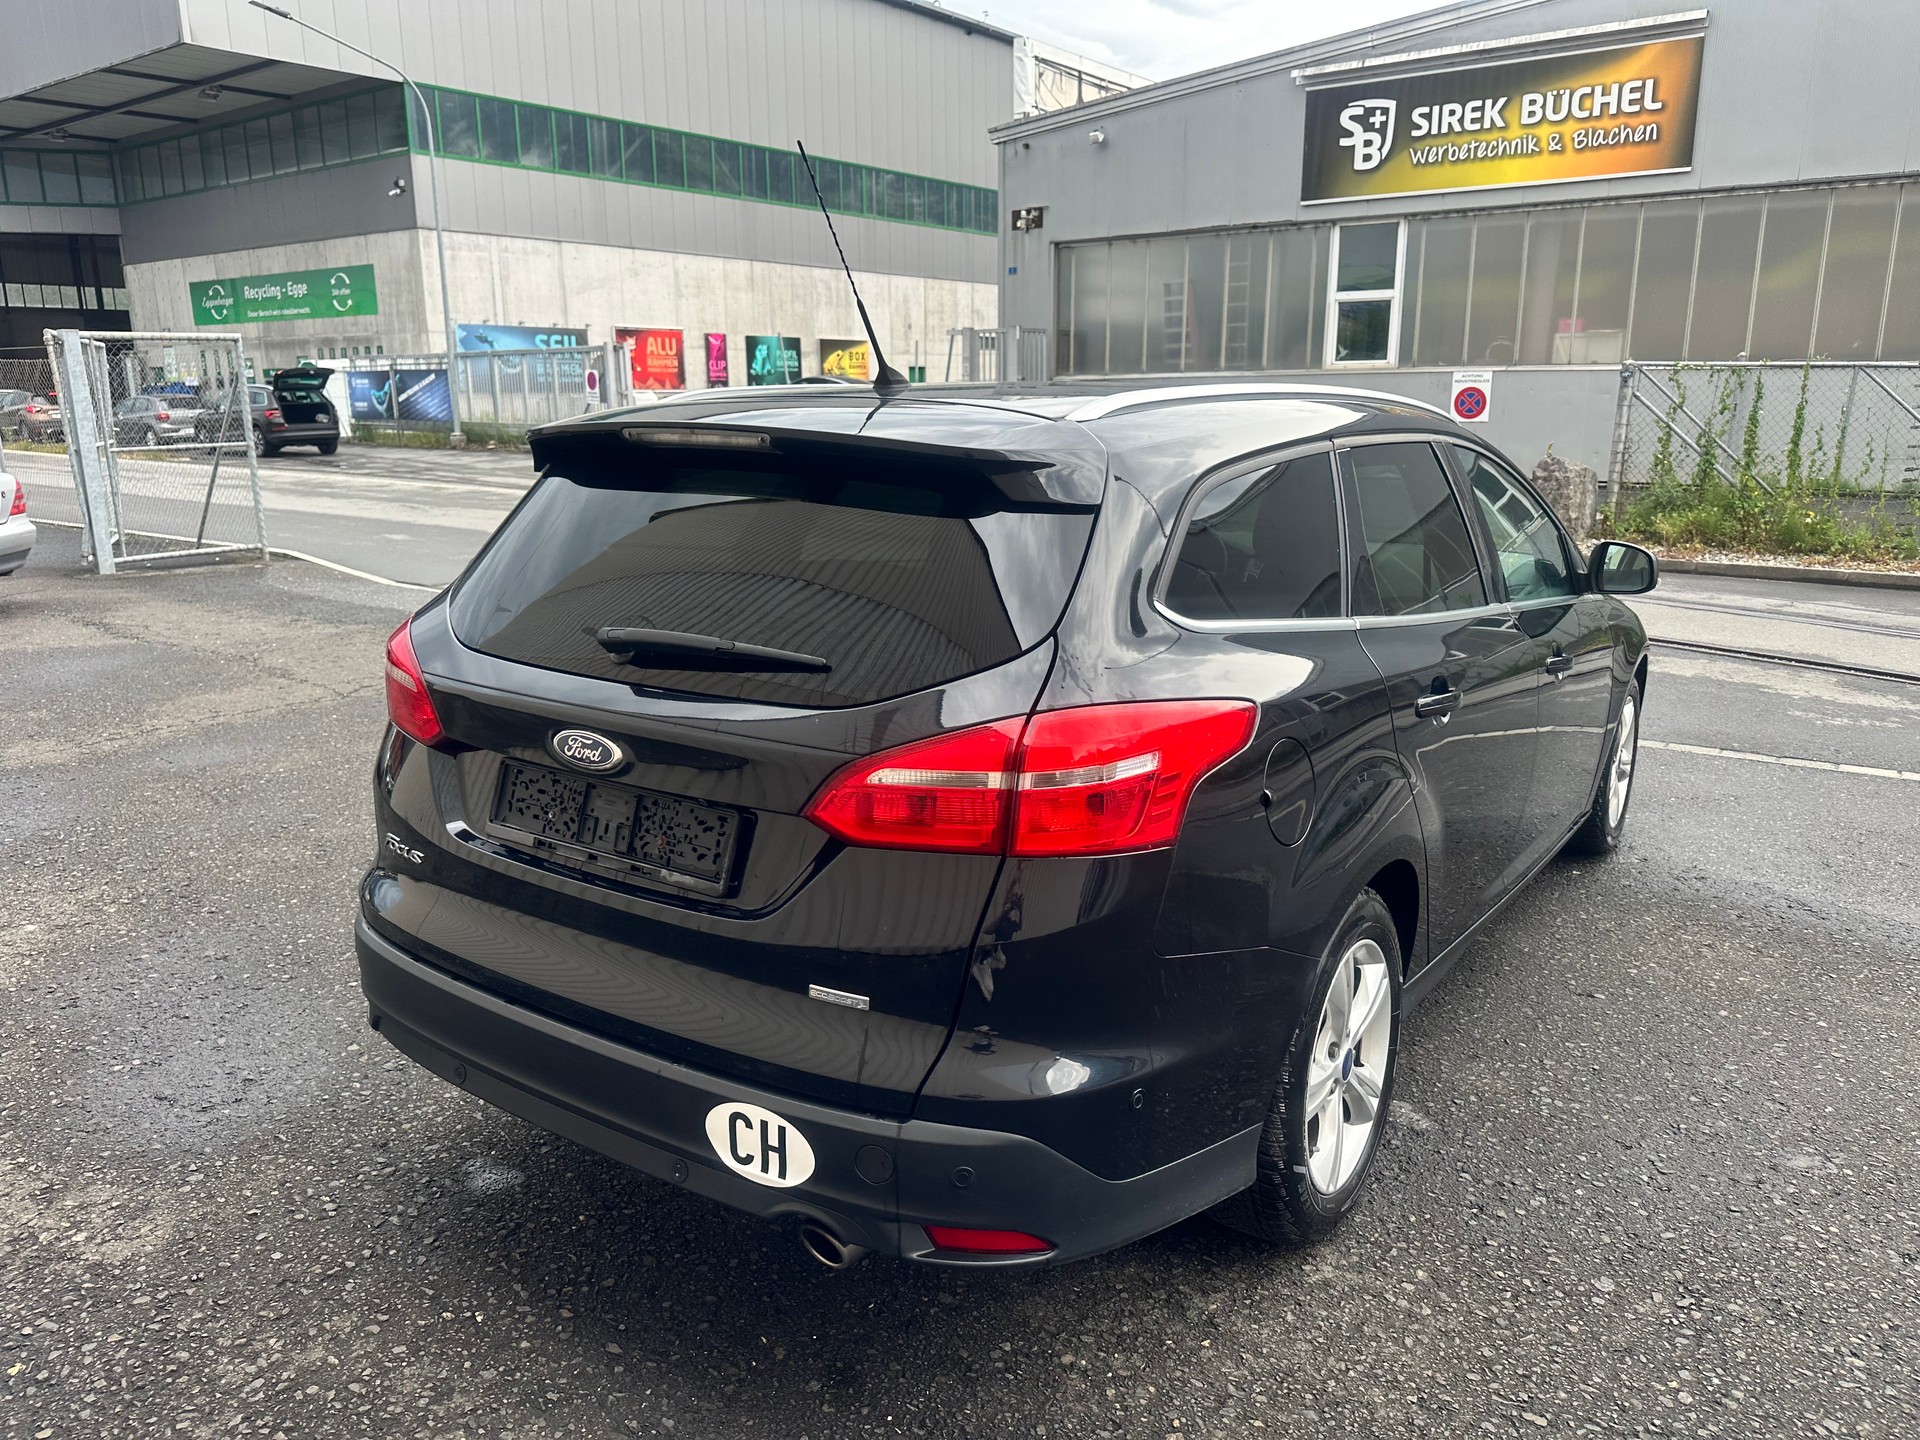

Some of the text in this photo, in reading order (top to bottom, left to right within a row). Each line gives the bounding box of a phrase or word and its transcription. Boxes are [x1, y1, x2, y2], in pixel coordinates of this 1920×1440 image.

[1411, 78, 1664, 137] SIREK BÜCHEL
[1548, 133, 1562, 151] &
[1571, 122, 1659, 149] Blachen
[244, 284, 281, 301] Recycling
[287, 281, 308, 298] Egge
[646, 337, 677, 355] ALU
[848, 351, 866, 361] BOX
[709, 360, 727, 371] CLIP
[564, 736, 602, 761] Ford
[728, 1111, 787, 1180] CH
